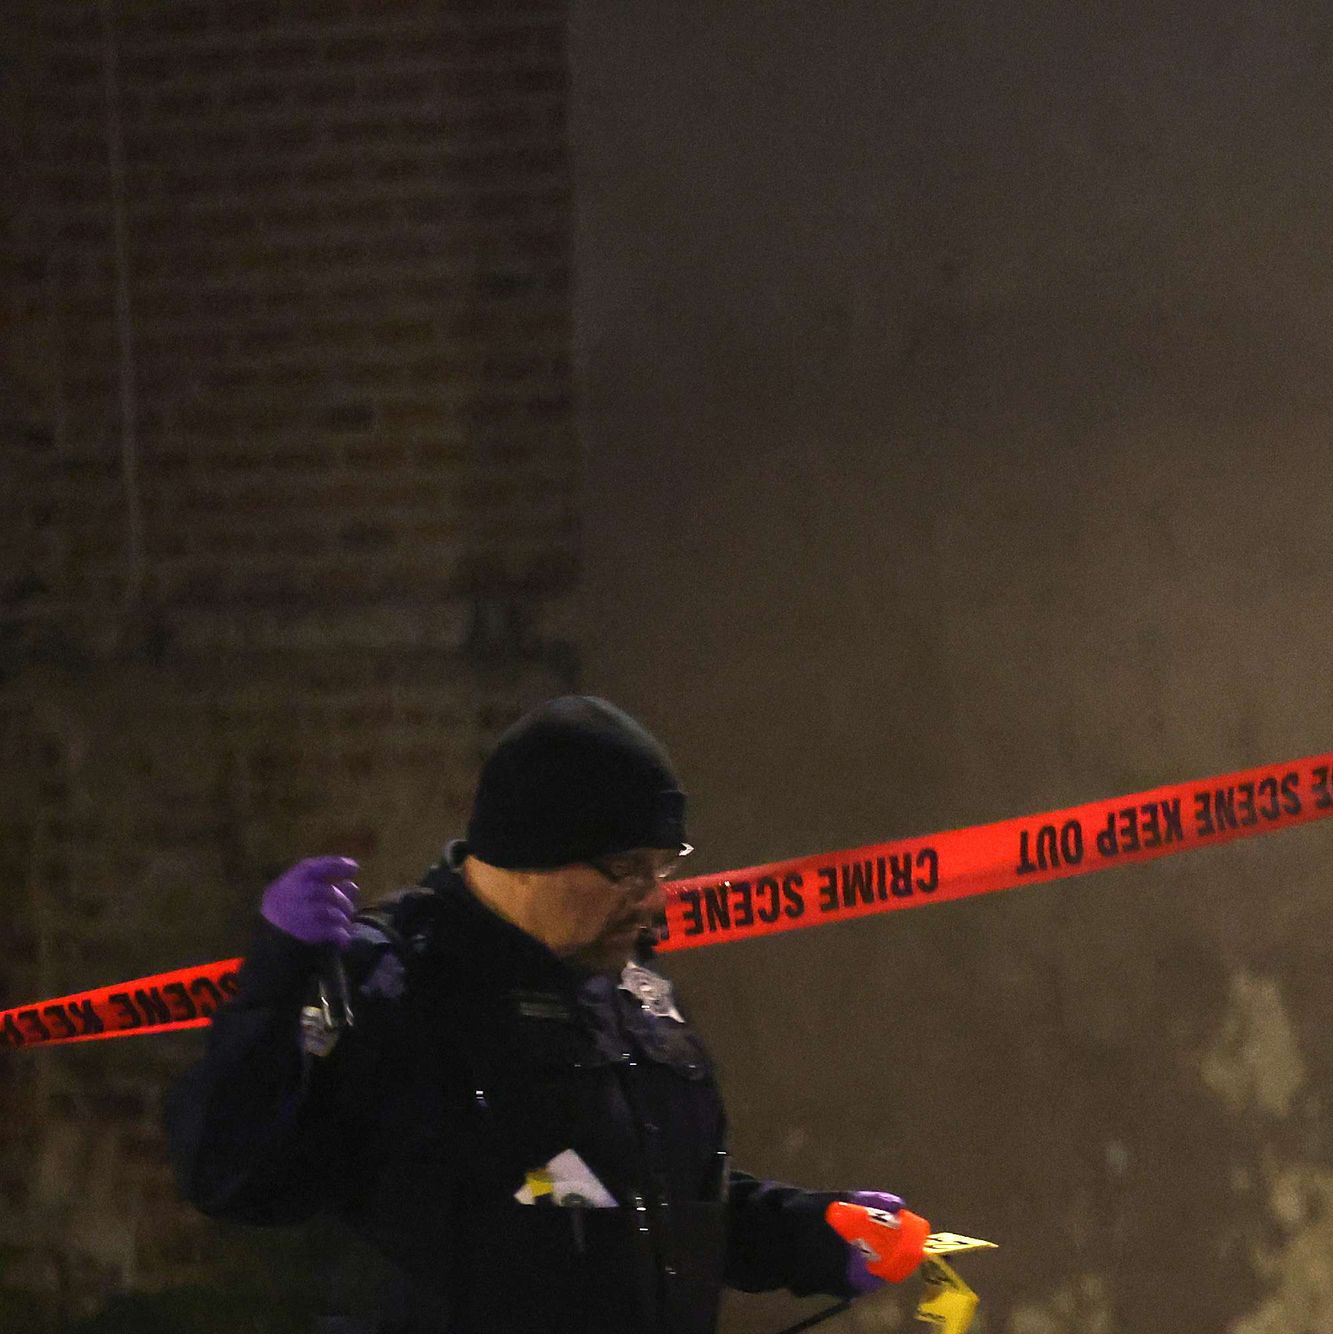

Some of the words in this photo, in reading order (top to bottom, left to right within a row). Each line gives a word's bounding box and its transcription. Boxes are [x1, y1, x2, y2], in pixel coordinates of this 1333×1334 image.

[1096, 797, 1184, 857] KEEP
[1194, 772, 1303, 836] SCENE
[1016, 818, 1084, 875] OUT
[679, 873, 805, 935] SCENE
[818, 847, 940, 913] CRIME
[108, 972, 240, 1030] SCENE
